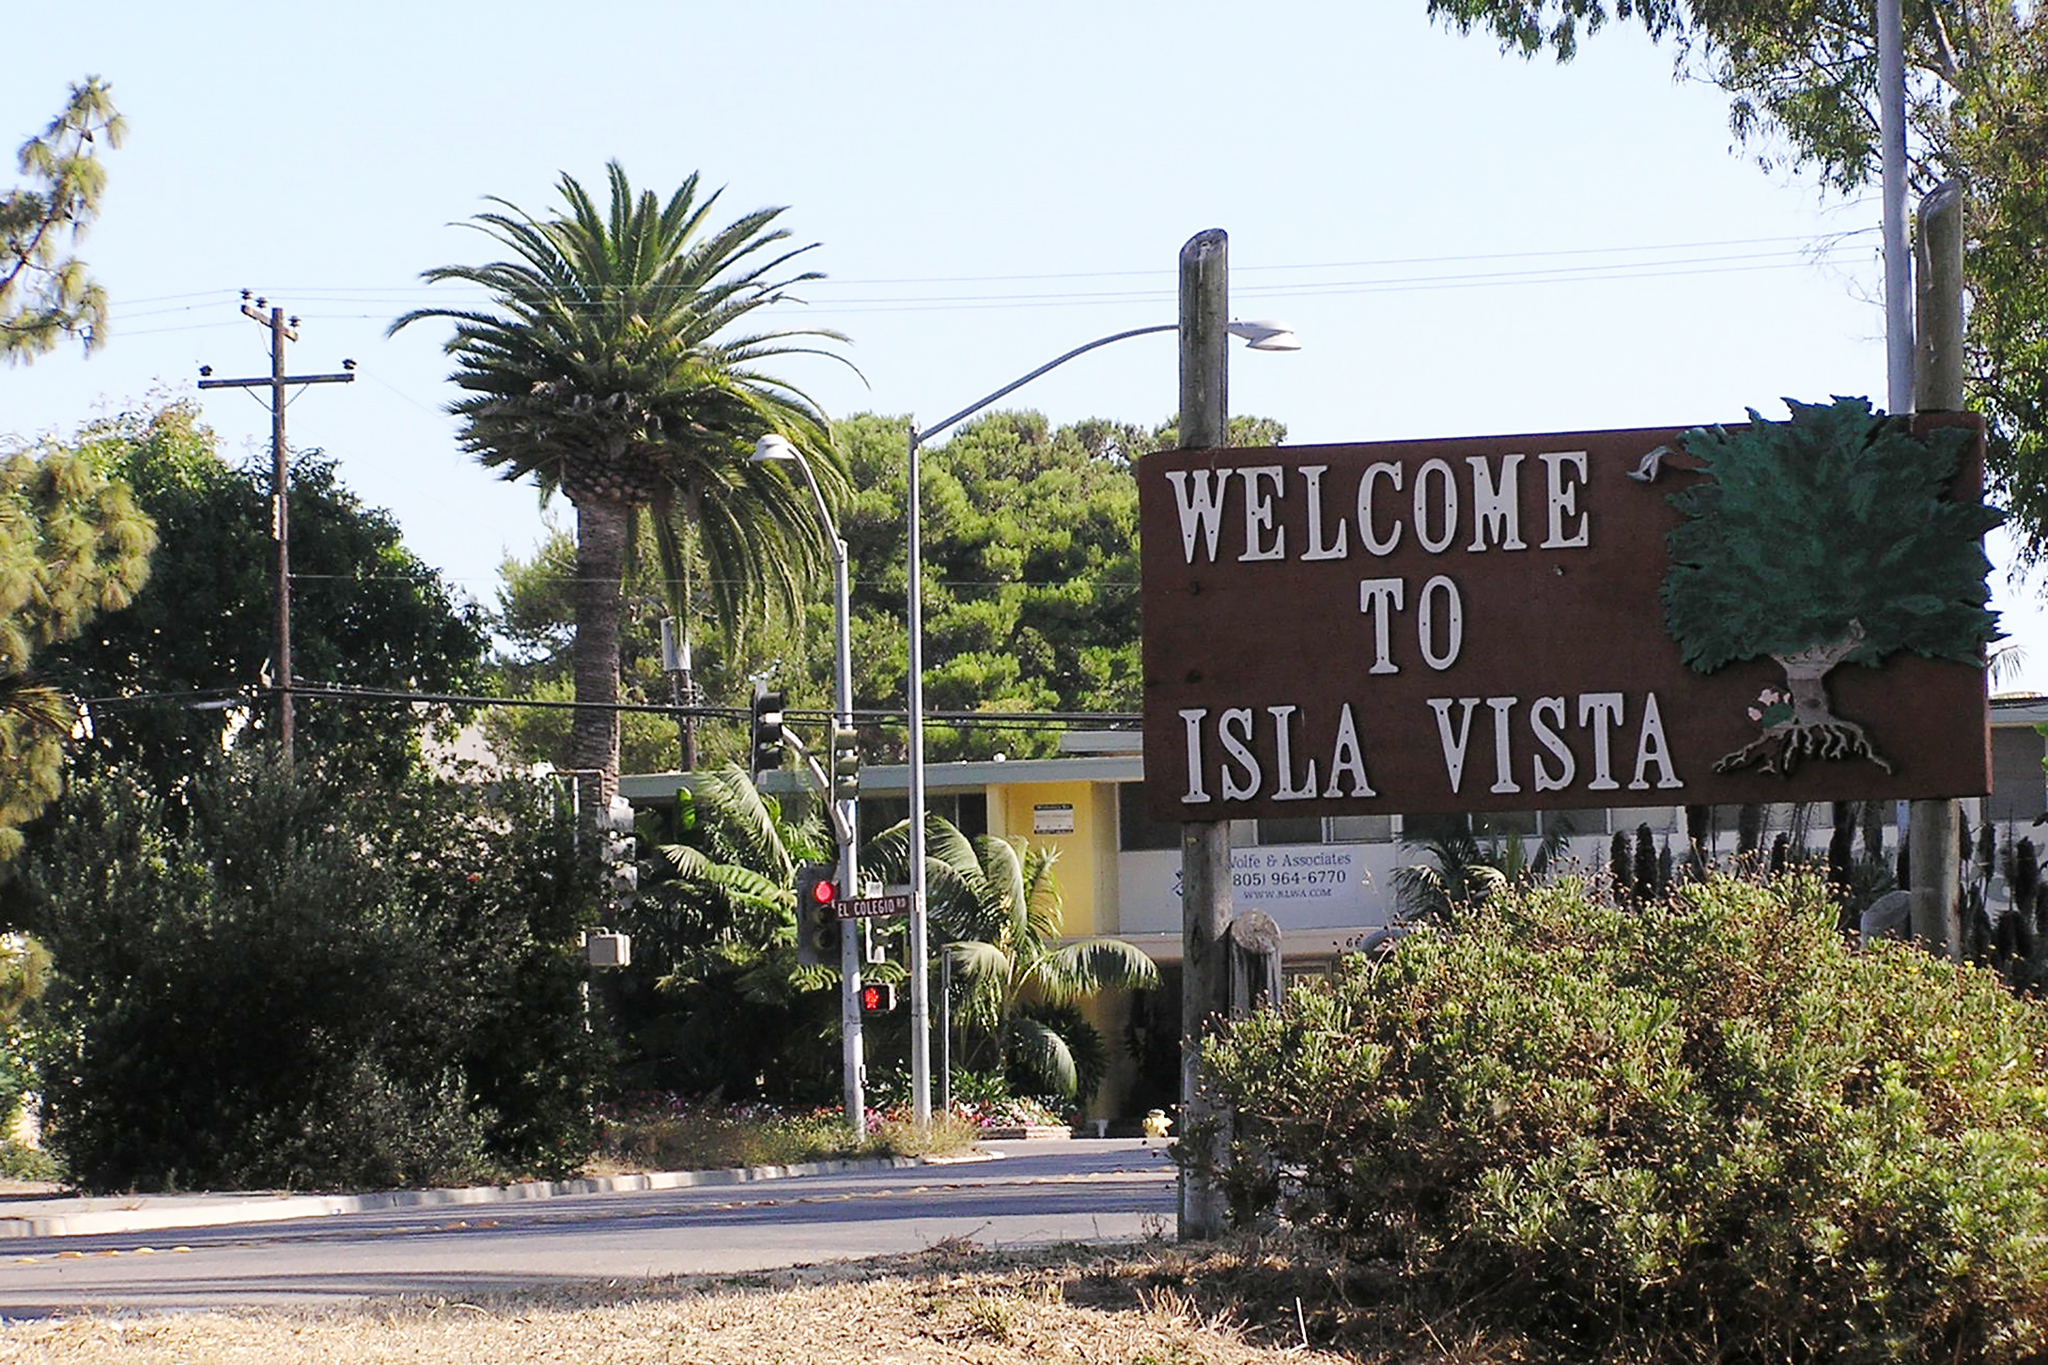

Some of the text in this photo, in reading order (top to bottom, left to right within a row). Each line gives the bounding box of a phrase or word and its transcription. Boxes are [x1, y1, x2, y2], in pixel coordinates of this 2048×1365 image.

[1165, 451, 1589, 563] WELCOME
[1361, 576, 1463, 674] TO
[1179, 692, 1684, 802] ISLA VISTA
[1267, 854, 1277, 867] &
[1282, 853, 1351, 867] Associates
[1271, 870, 1346, 886] 964-6770
[838, 897, 907, 917] EL COLEGIO RD
